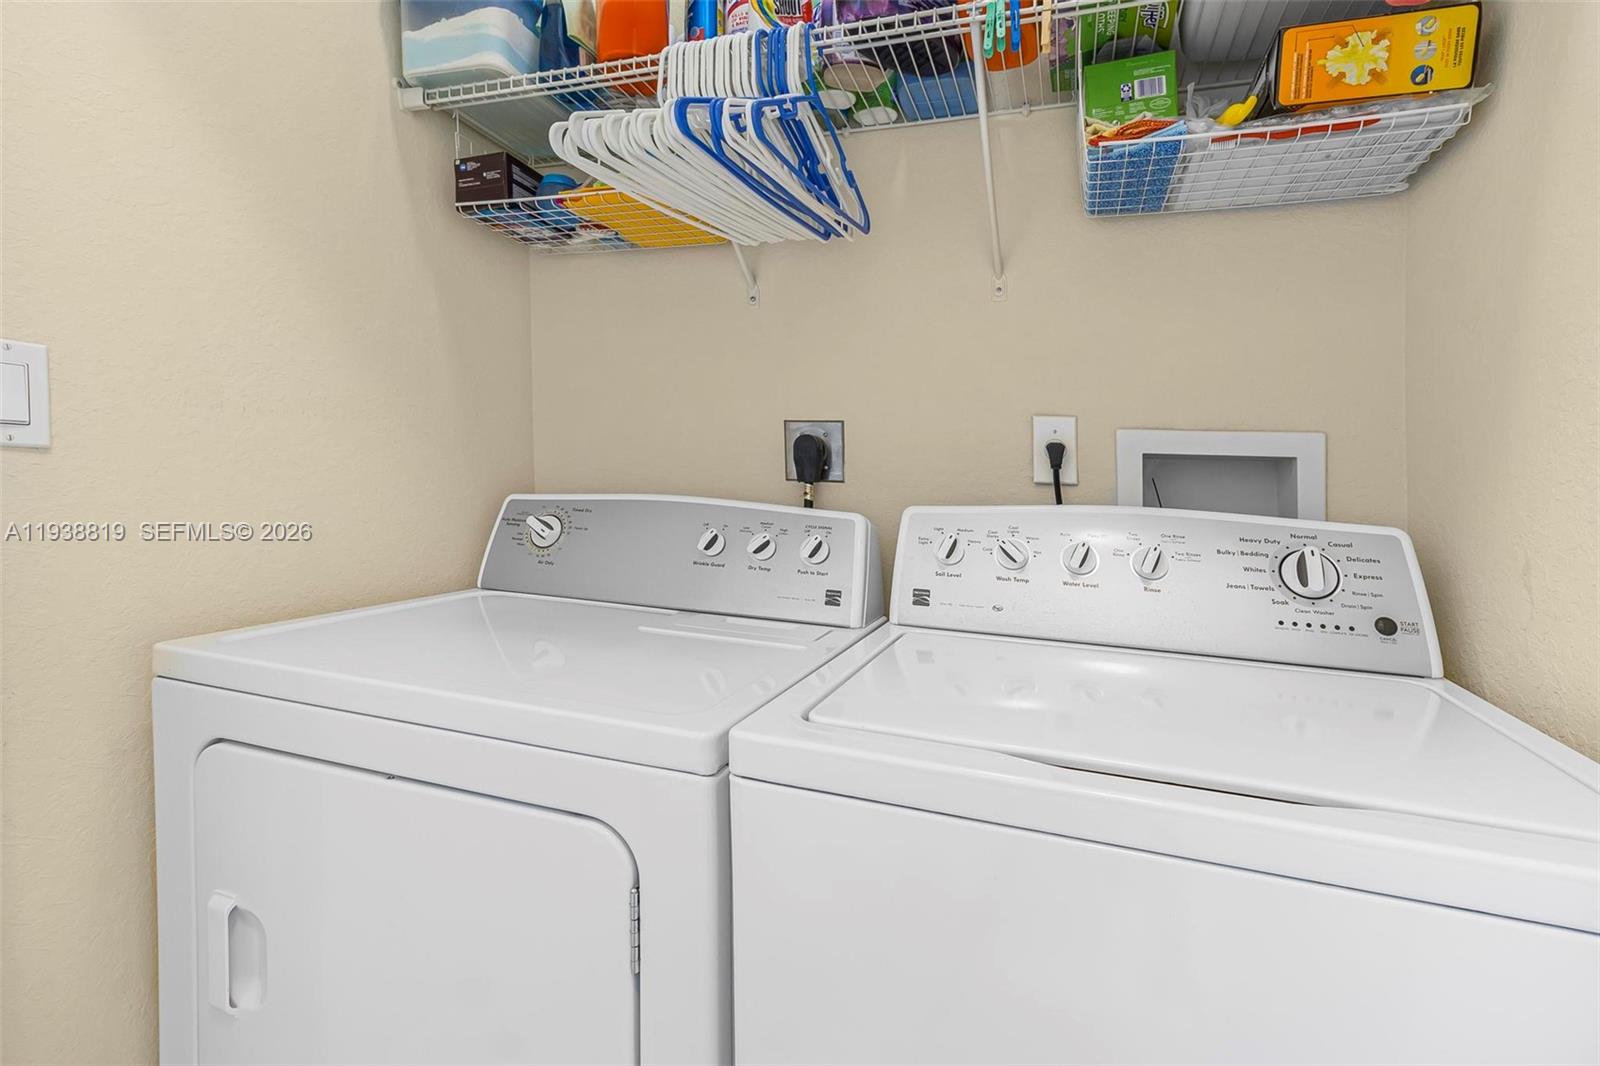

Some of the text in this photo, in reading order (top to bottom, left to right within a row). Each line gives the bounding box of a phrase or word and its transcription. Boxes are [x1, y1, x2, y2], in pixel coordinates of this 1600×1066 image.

[1240, 550, 1269, 558] Bedding
[1346, 556, 1381, 564] Delicates
[1242, 566, 1267, 574] Whites
[1353, 573, 1383, 581] Express
[1250, 584, 1275, 592] Towels
